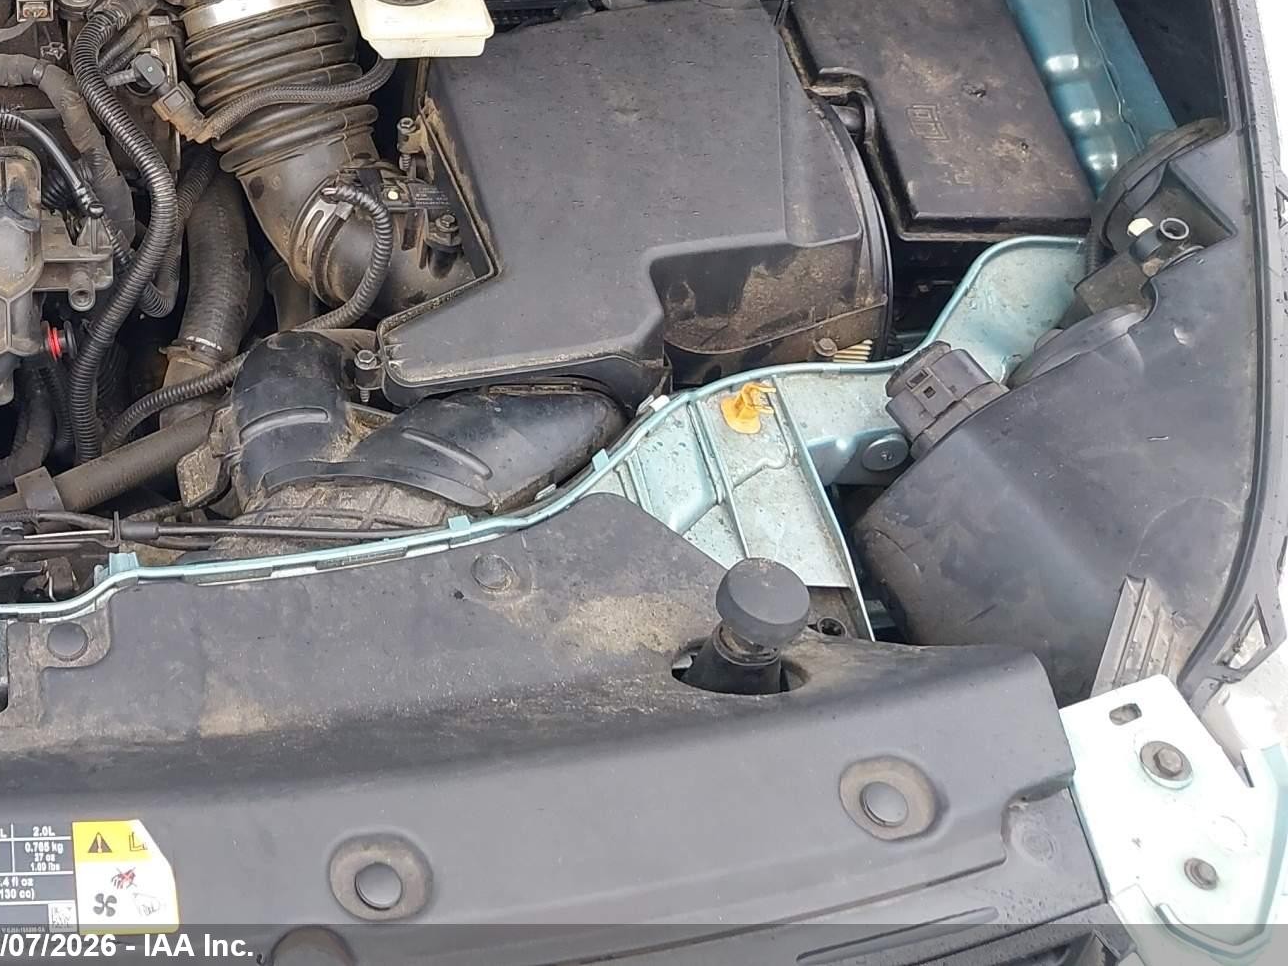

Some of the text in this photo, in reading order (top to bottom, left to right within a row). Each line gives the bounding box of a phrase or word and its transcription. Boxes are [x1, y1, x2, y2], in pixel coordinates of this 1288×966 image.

[32, 825, 56, 837] 2.0L
[51, 840, 64, 854] kg
[45, 853, 56, 863] oz
[48, 861, 61, 872] lbs
[11, 876, 19, 887] fl
[21, 878, 34, 886] oz
[19, 888, 35, 900] cc)
